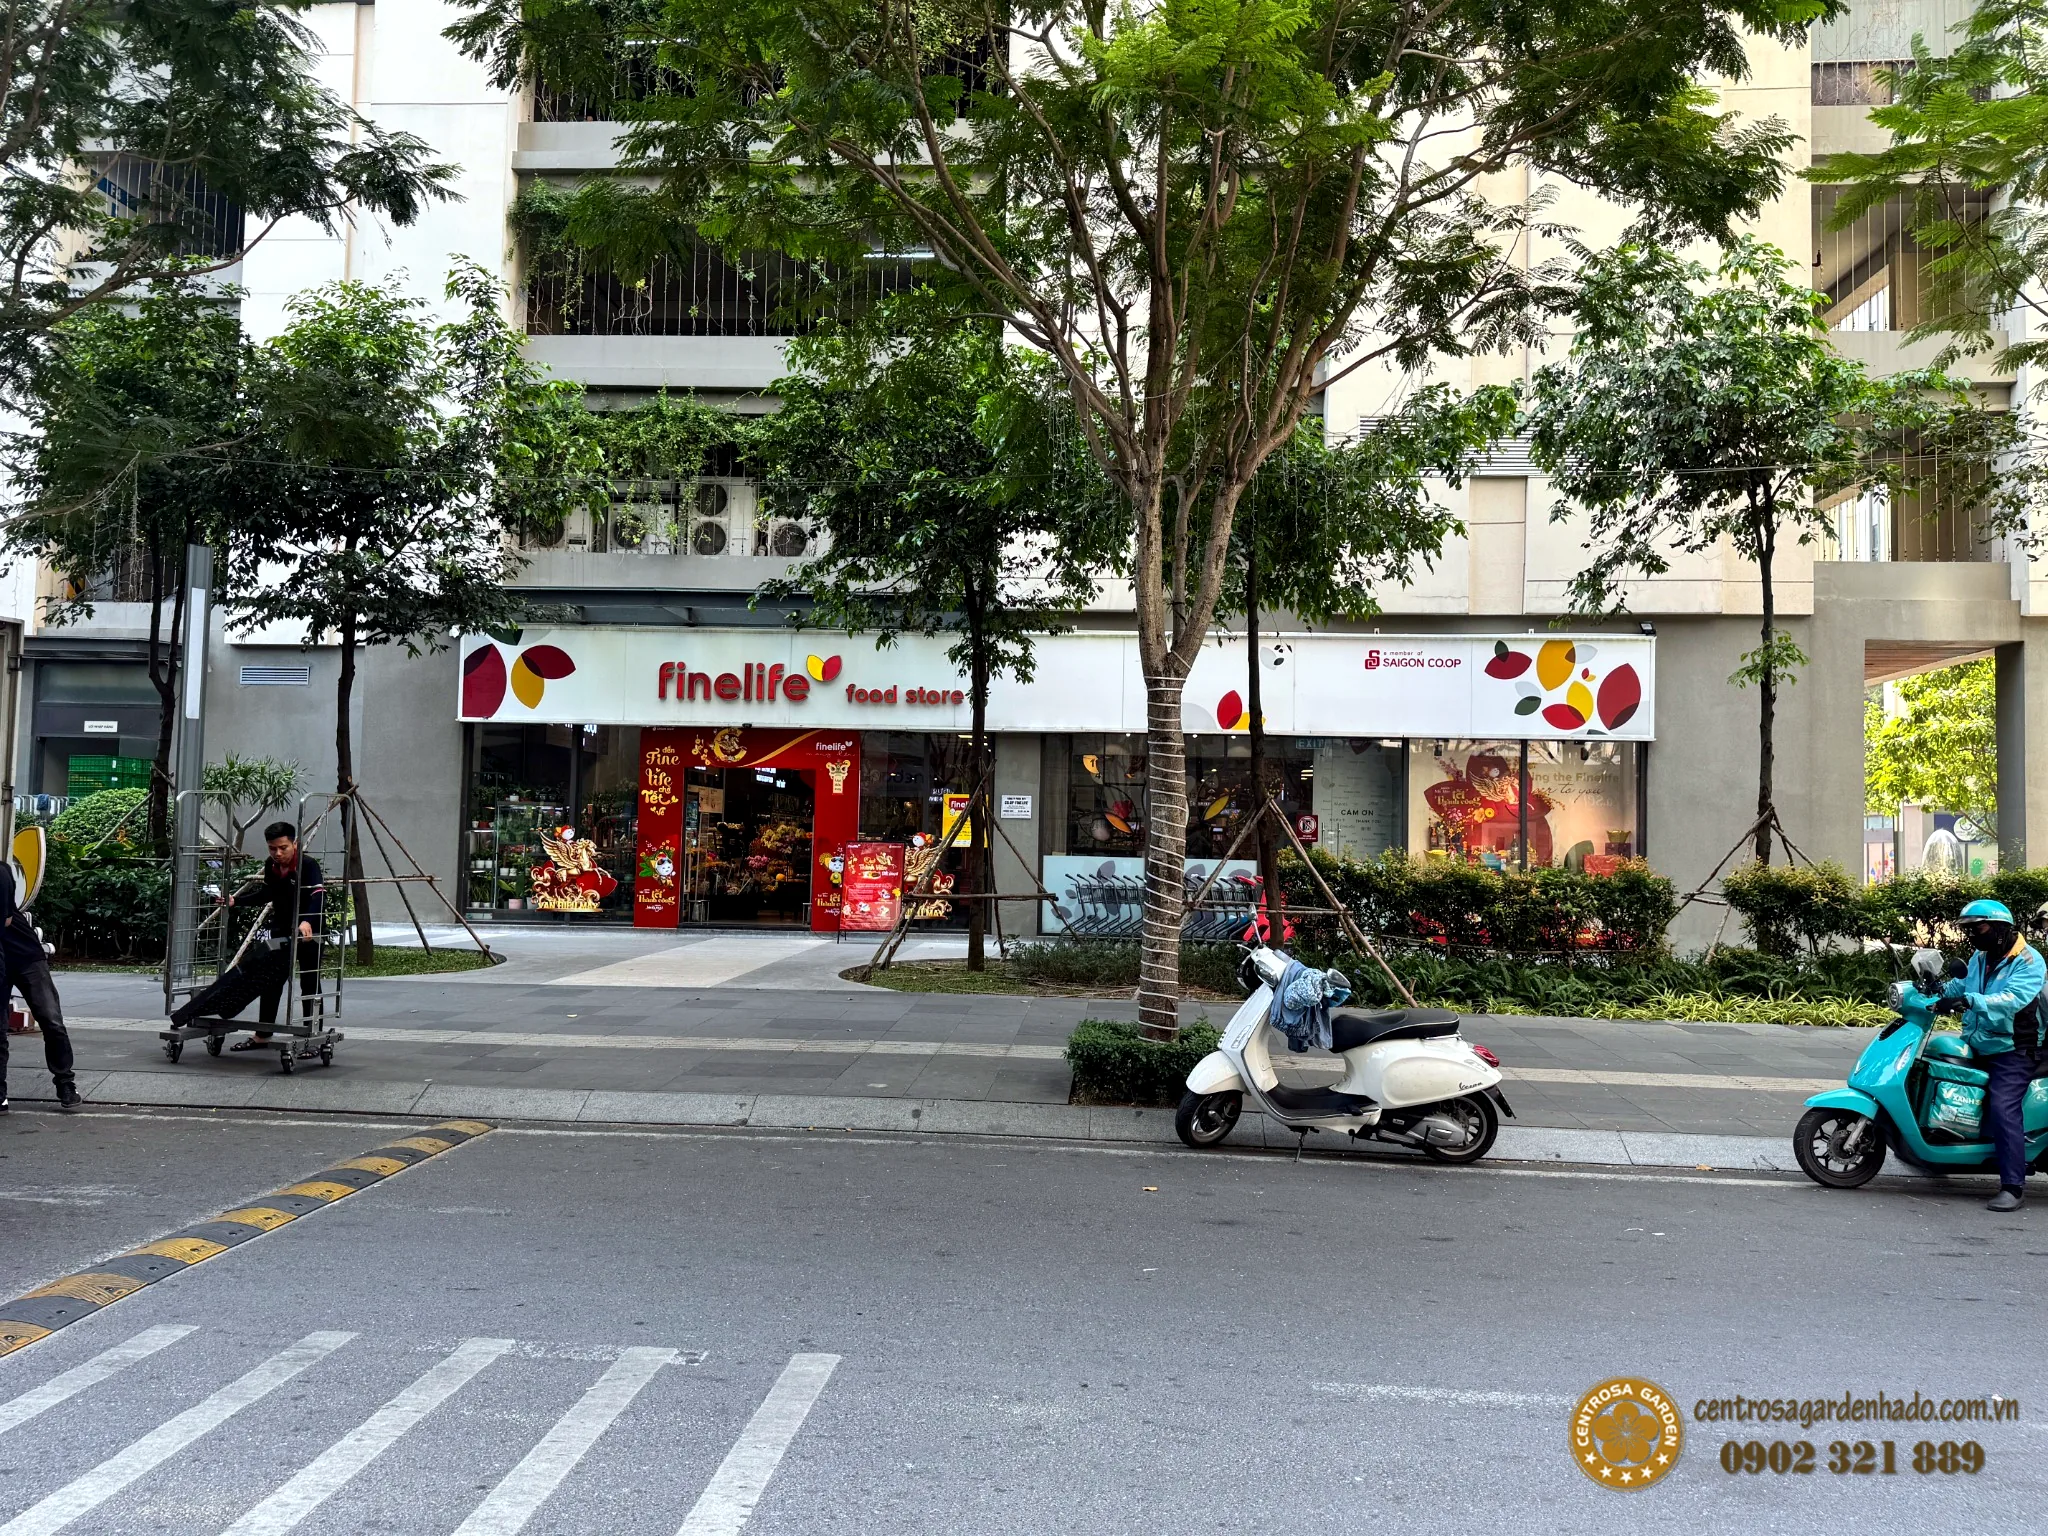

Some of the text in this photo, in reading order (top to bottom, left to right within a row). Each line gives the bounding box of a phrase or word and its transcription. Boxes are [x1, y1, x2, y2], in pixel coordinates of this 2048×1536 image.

[1383, 657, 1461, 668] SAIGON CO.OP
[658, 661, 810, 701] finelife
[846, 683, 965, 706] food store
[815, 742, 847, 751] finelife
[646, 747, 681, 766] Fine
[1553, 771, 1573, 782] the
[1952, 1094, 1975, 1105] XANH
